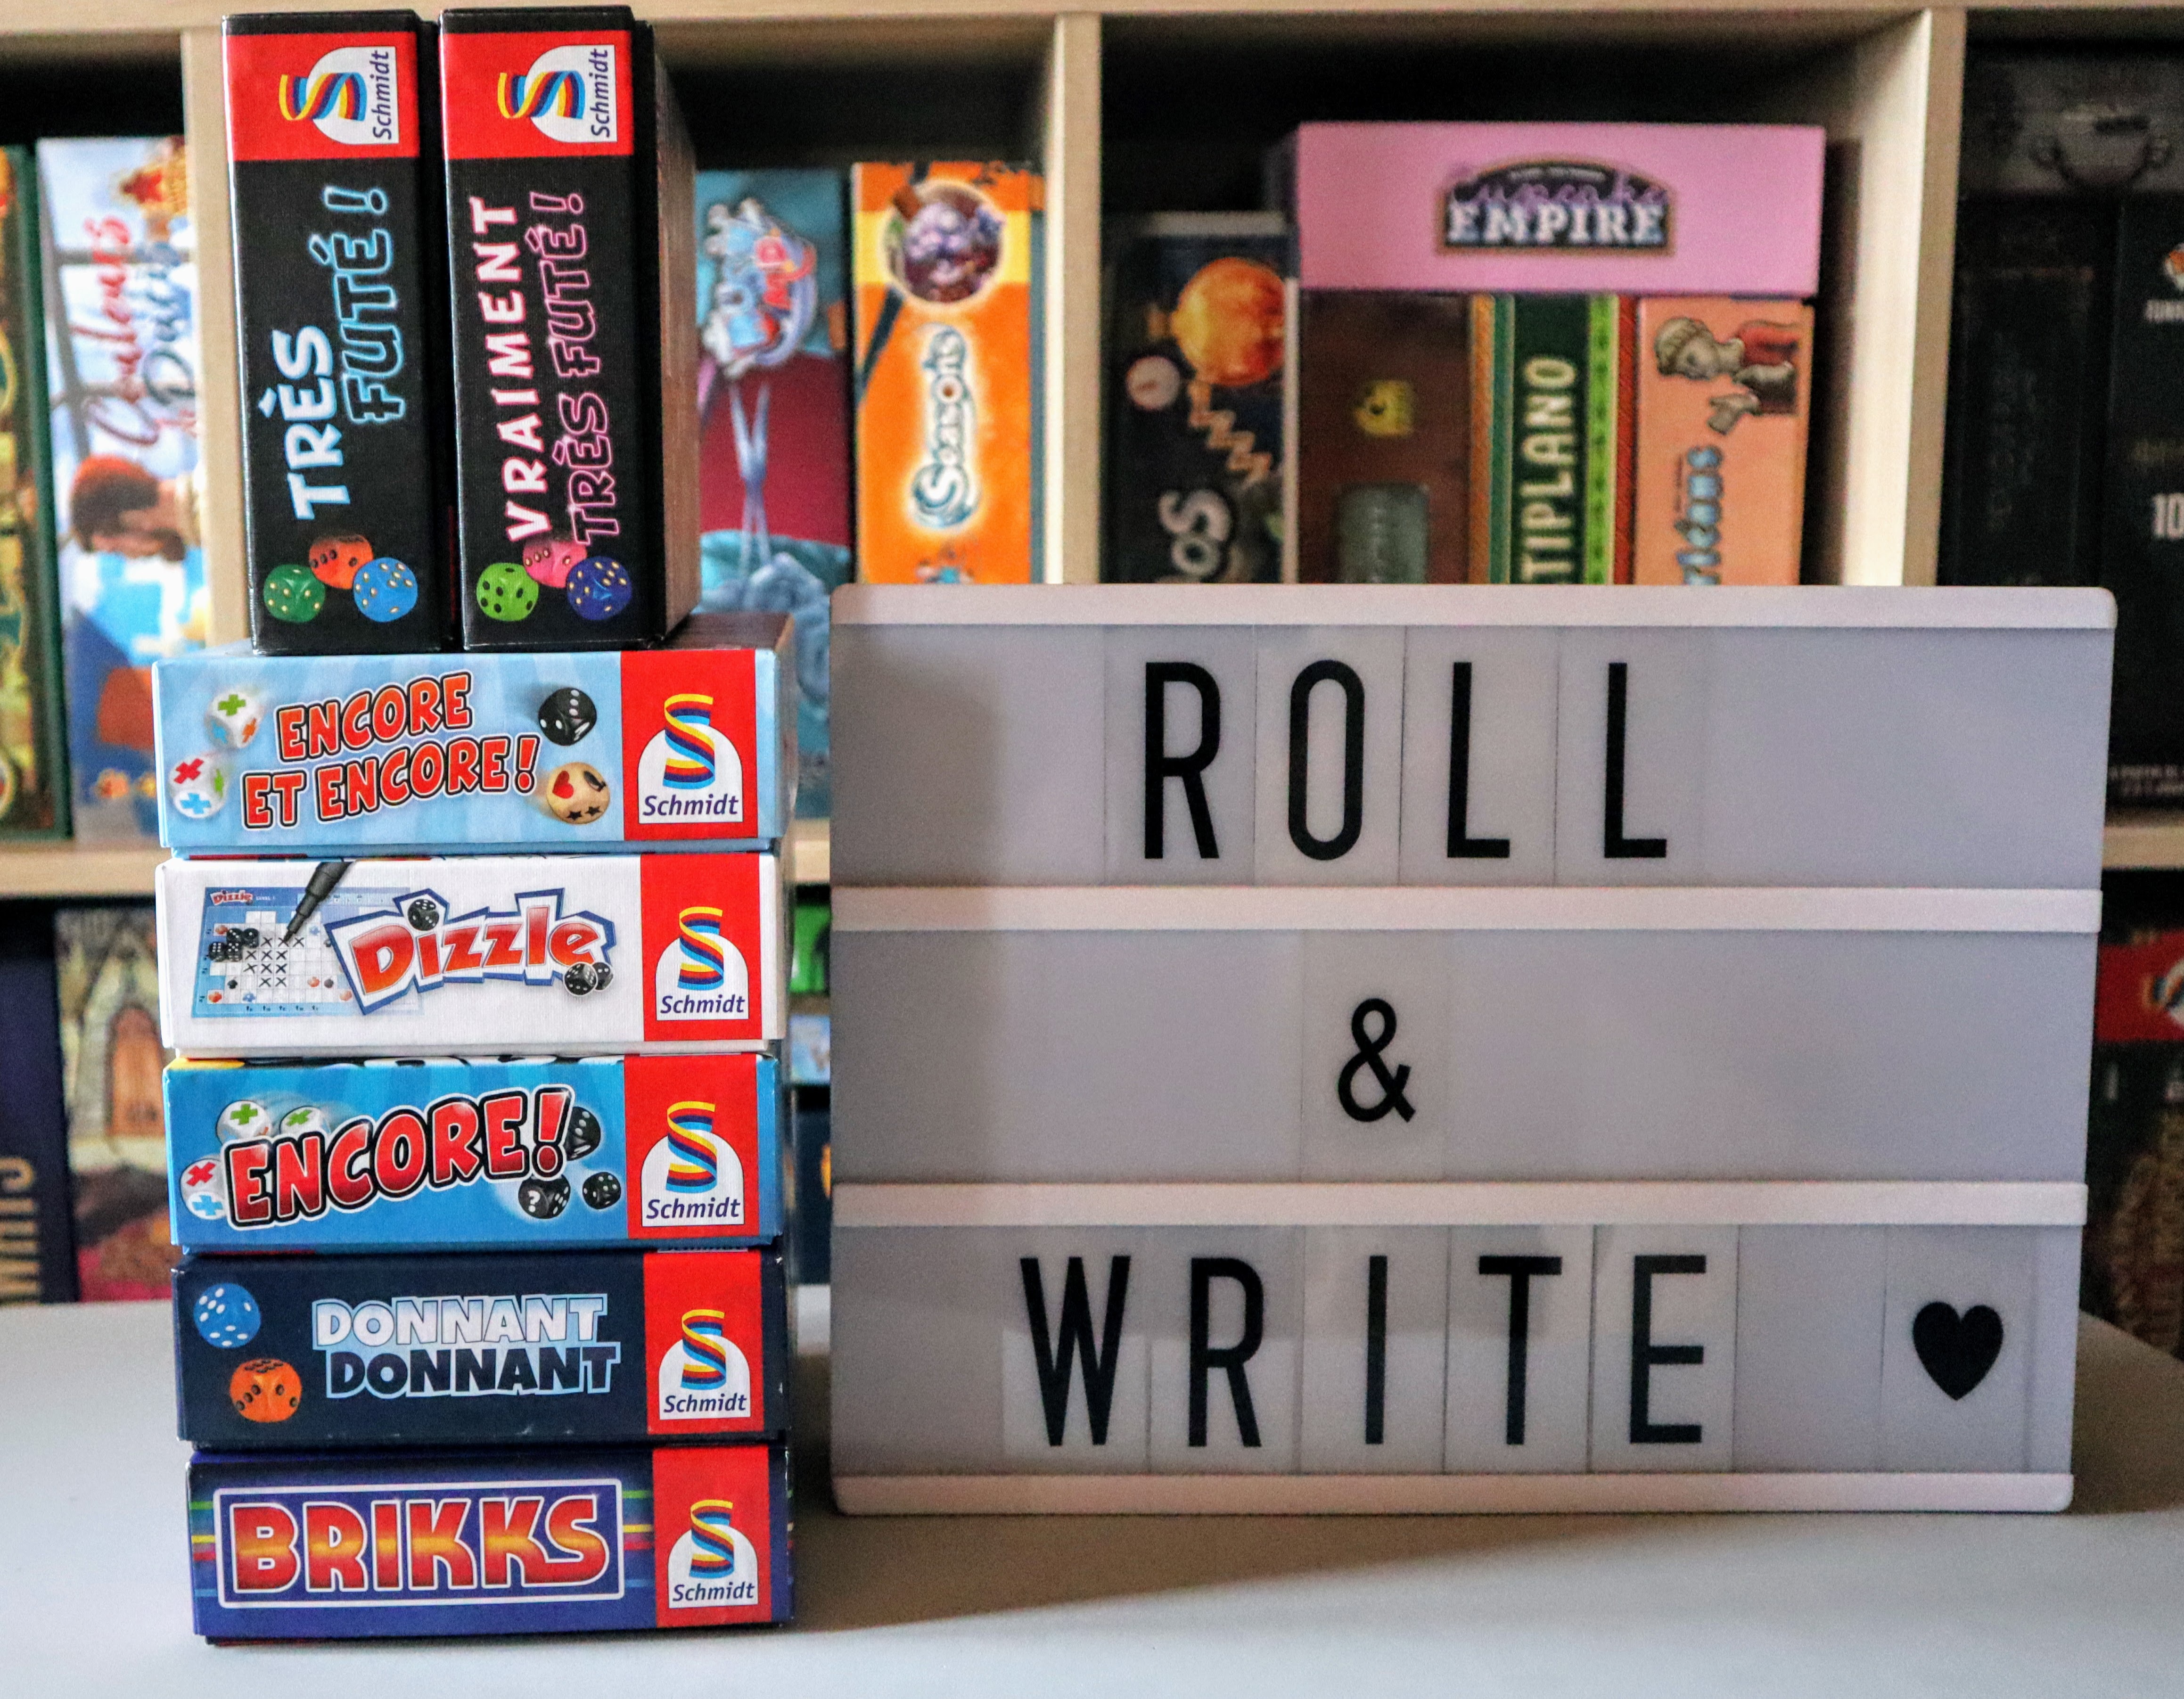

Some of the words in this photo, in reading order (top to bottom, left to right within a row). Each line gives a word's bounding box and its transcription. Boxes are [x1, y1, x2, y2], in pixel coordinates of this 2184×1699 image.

[373, 49, 392, 140] Schmidt
[591, 49, 610, 138] Schmidt
[1447, 200, 1666, 244] EMPIRE
[469, 196, 552, 542] VRAIMENT
[258, 326, 350, 520] TRÈS
[912, 328, 969, 514] Seasons
[552, 392, 621, 545] TRÈS
[1521, 355, 1577, 583] TIPLANO
[276, 671, 472, 761] ENCORE
[1144, 659, 1667, 861] ROLL
[243, 771, 306, 828] ET
[317, 734, 540, 822] ENCORE!
[642, 793, 739, 816] Schmidt
[346, 898, 602, 996] Dizzle
[660, 994, 746, 1014] Schmidt
[1338, 998, 1415, 1123] &
[223, 1085, 574, 1229] ENCORE!
[646, 1197, 740, 1219] Schmidt
[313, 1294, 608, 1348] DONNANT
[1019, 1255, 1707, 1447] WRITE
[326, 1343, 620, 1398] DONNANT
[664, 1392, 747, 1413] Schmidt
[230, 1494, 610, 1593] BRIKKS
[673, 1581, 755, 1602] Schmidt
